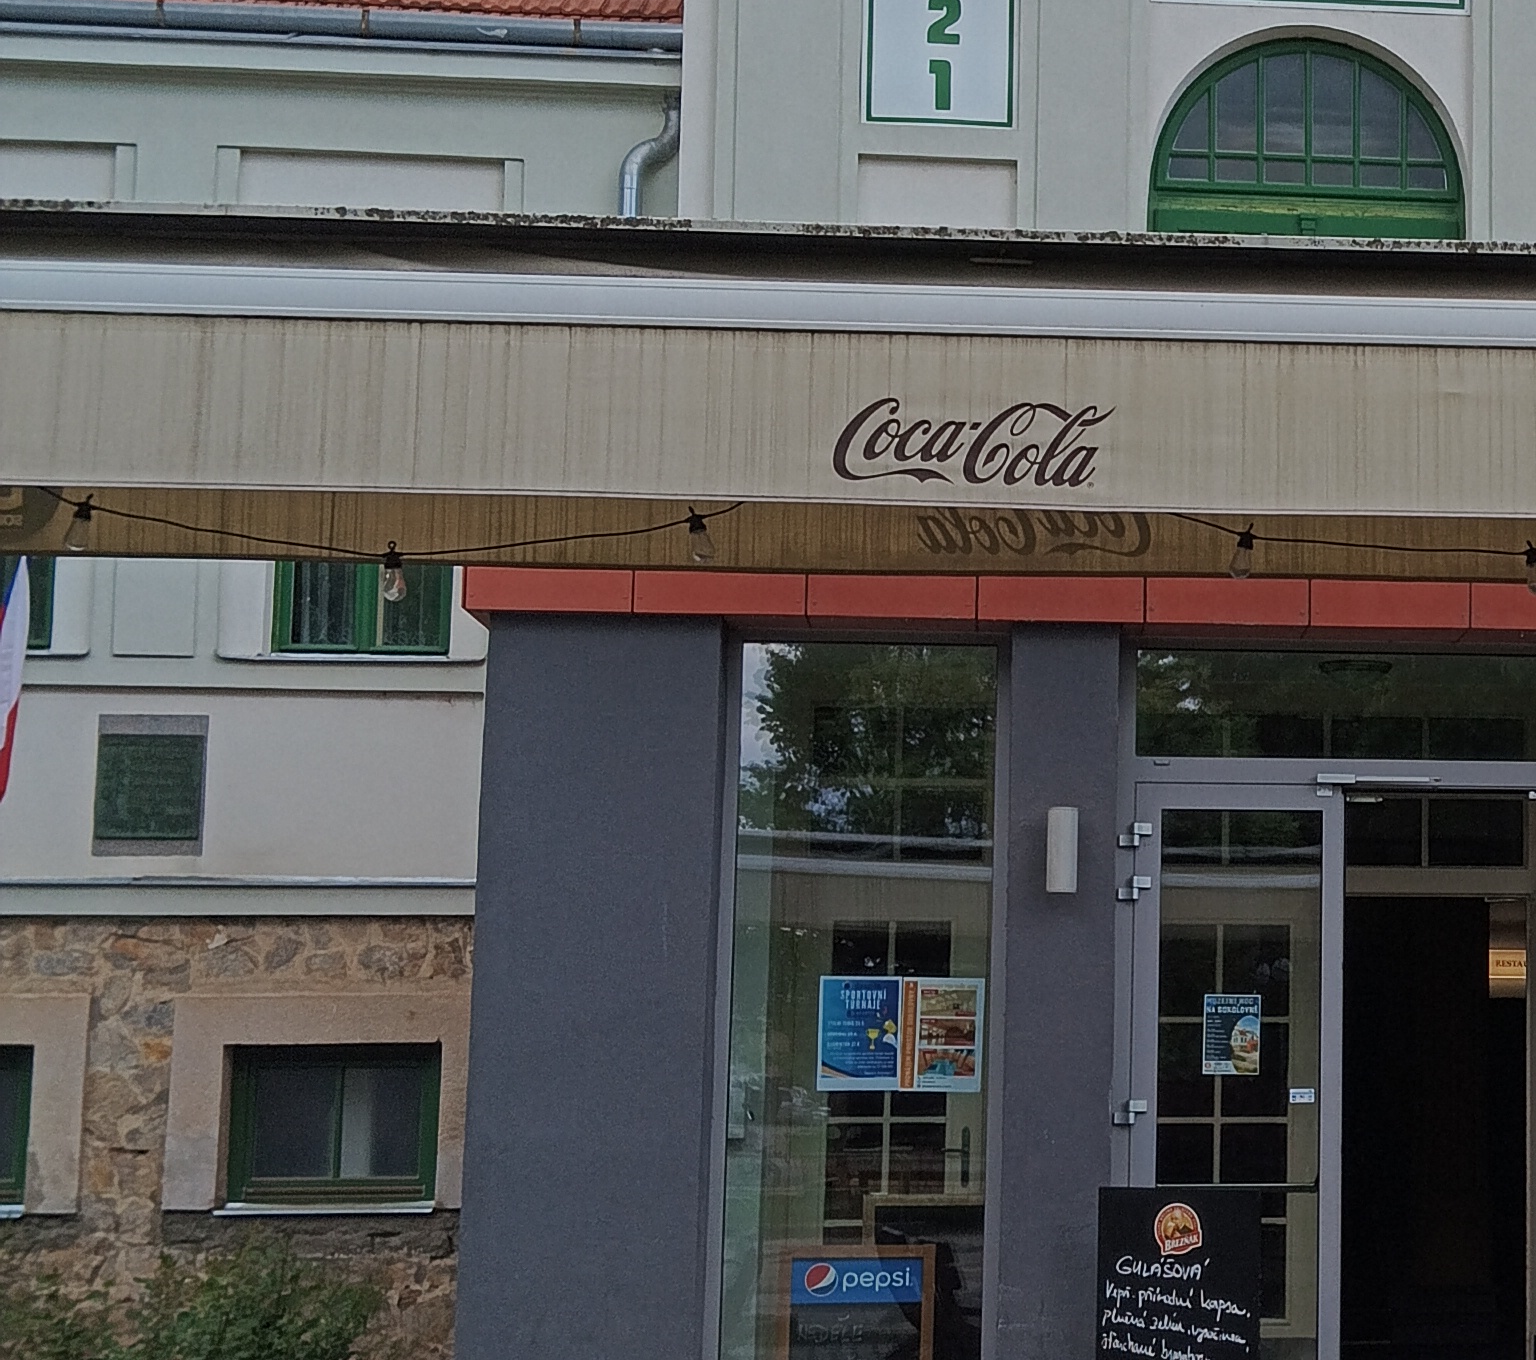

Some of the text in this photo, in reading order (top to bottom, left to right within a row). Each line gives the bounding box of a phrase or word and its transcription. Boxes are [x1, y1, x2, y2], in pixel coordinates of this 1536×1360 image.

[833, 397, 1116, 488] Coca-Cola
[840, 988, 887, 1000] SPORTOVNÍ
[845, 999, 881, 1010] TURNAJE
[842, 1266, 911, 1293] pepsi
[1115, 1255, 1211, 1281] GULÁŠOVÁ
